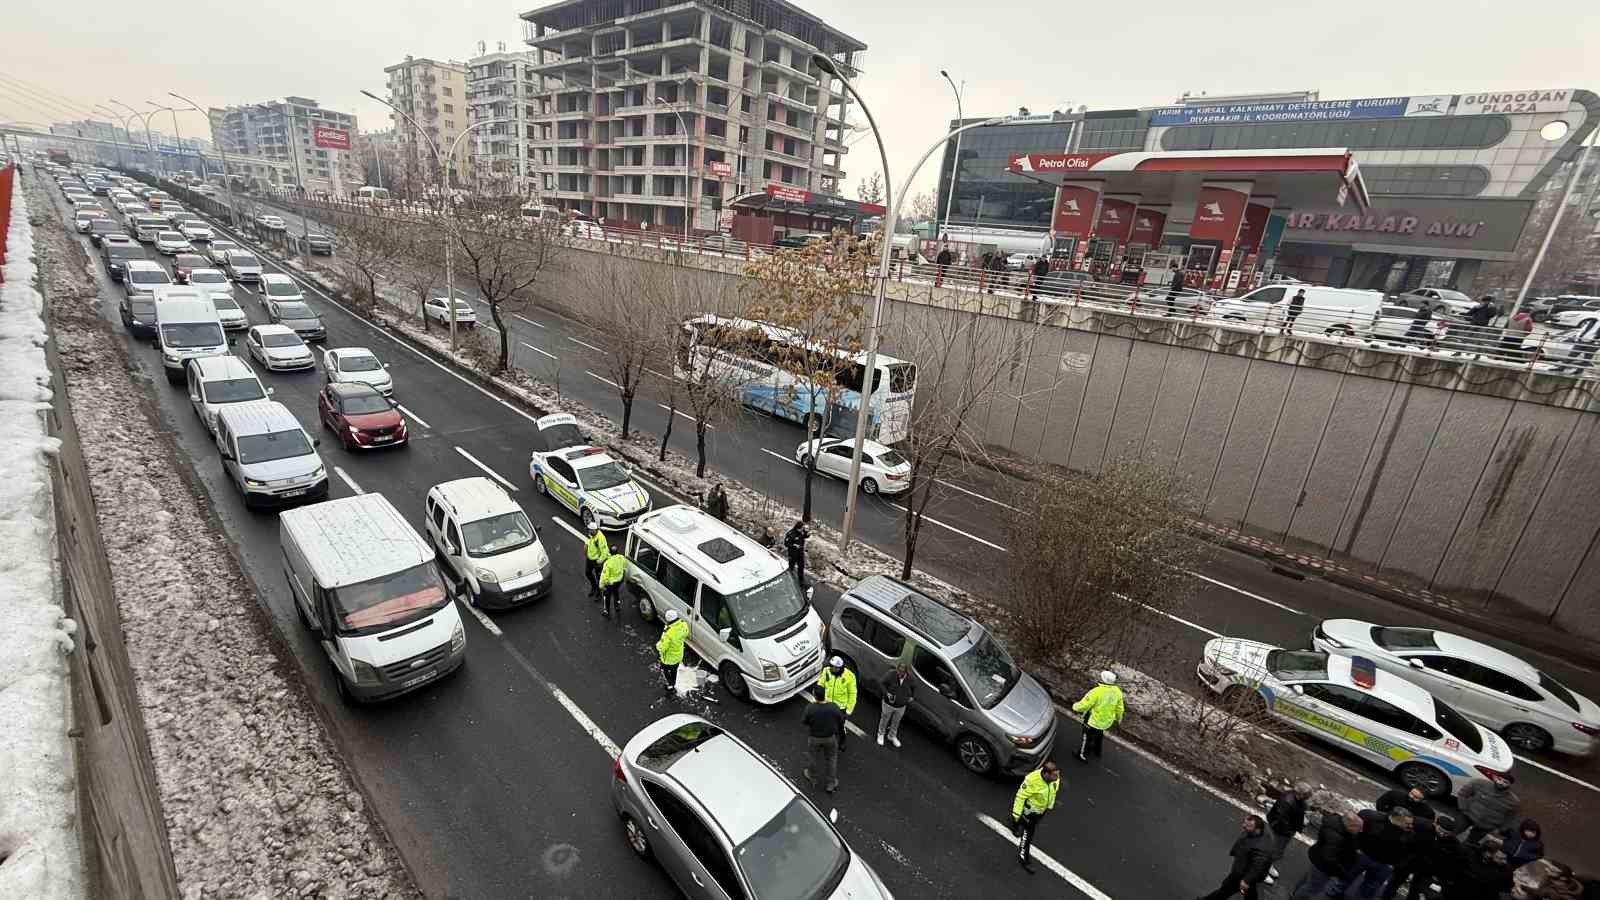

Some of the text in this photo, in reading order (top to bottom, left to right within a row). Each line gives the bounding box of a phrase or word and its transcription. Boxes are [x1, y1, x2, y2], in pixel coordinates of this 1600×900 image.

[1287, 100, 1352, 110] DESTEKLEME
[1356, 97, 1403, 108] KURUMU
[1481, 103, 1537, 113] PLAZA
[1039, 158, 1089, 168] Petrol Ofisi
[1426, 221, 1478, 238] AVM
